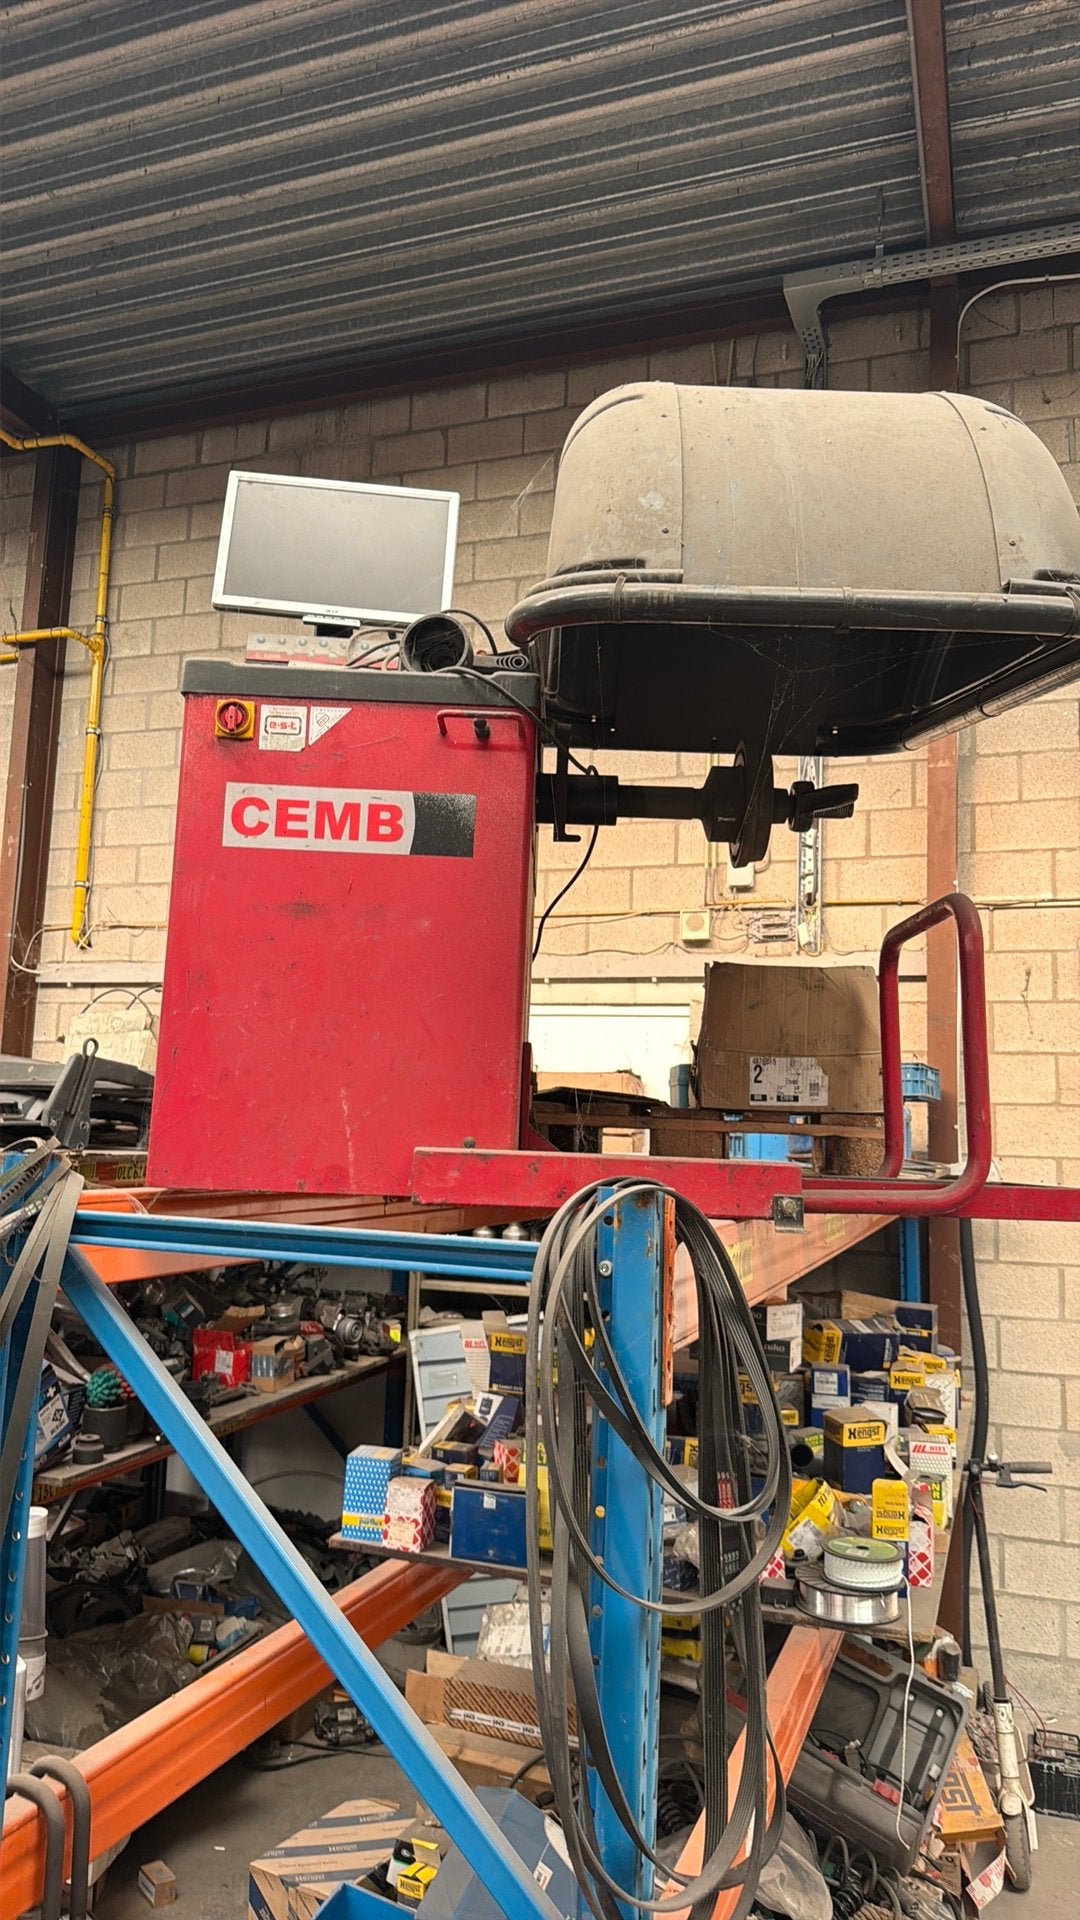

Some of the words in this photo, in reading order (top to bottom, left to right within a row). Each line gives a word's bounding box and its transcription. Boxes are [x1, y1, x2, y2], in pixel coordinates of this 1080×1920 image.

[231, 796, 405, 843] CEMB
[753, 1064, 763, 1084] 2
[495, 1336, 523, 1348] Hengst
[893, 1375, 922, 1386] Hengst
[848, 1425, 881, 1440] Hengst
[876, 1525, 905, 1536] Hengst
[328, 1844, 357, 1853] Hengst
[295, 1874, 325, 1882] Hengst
